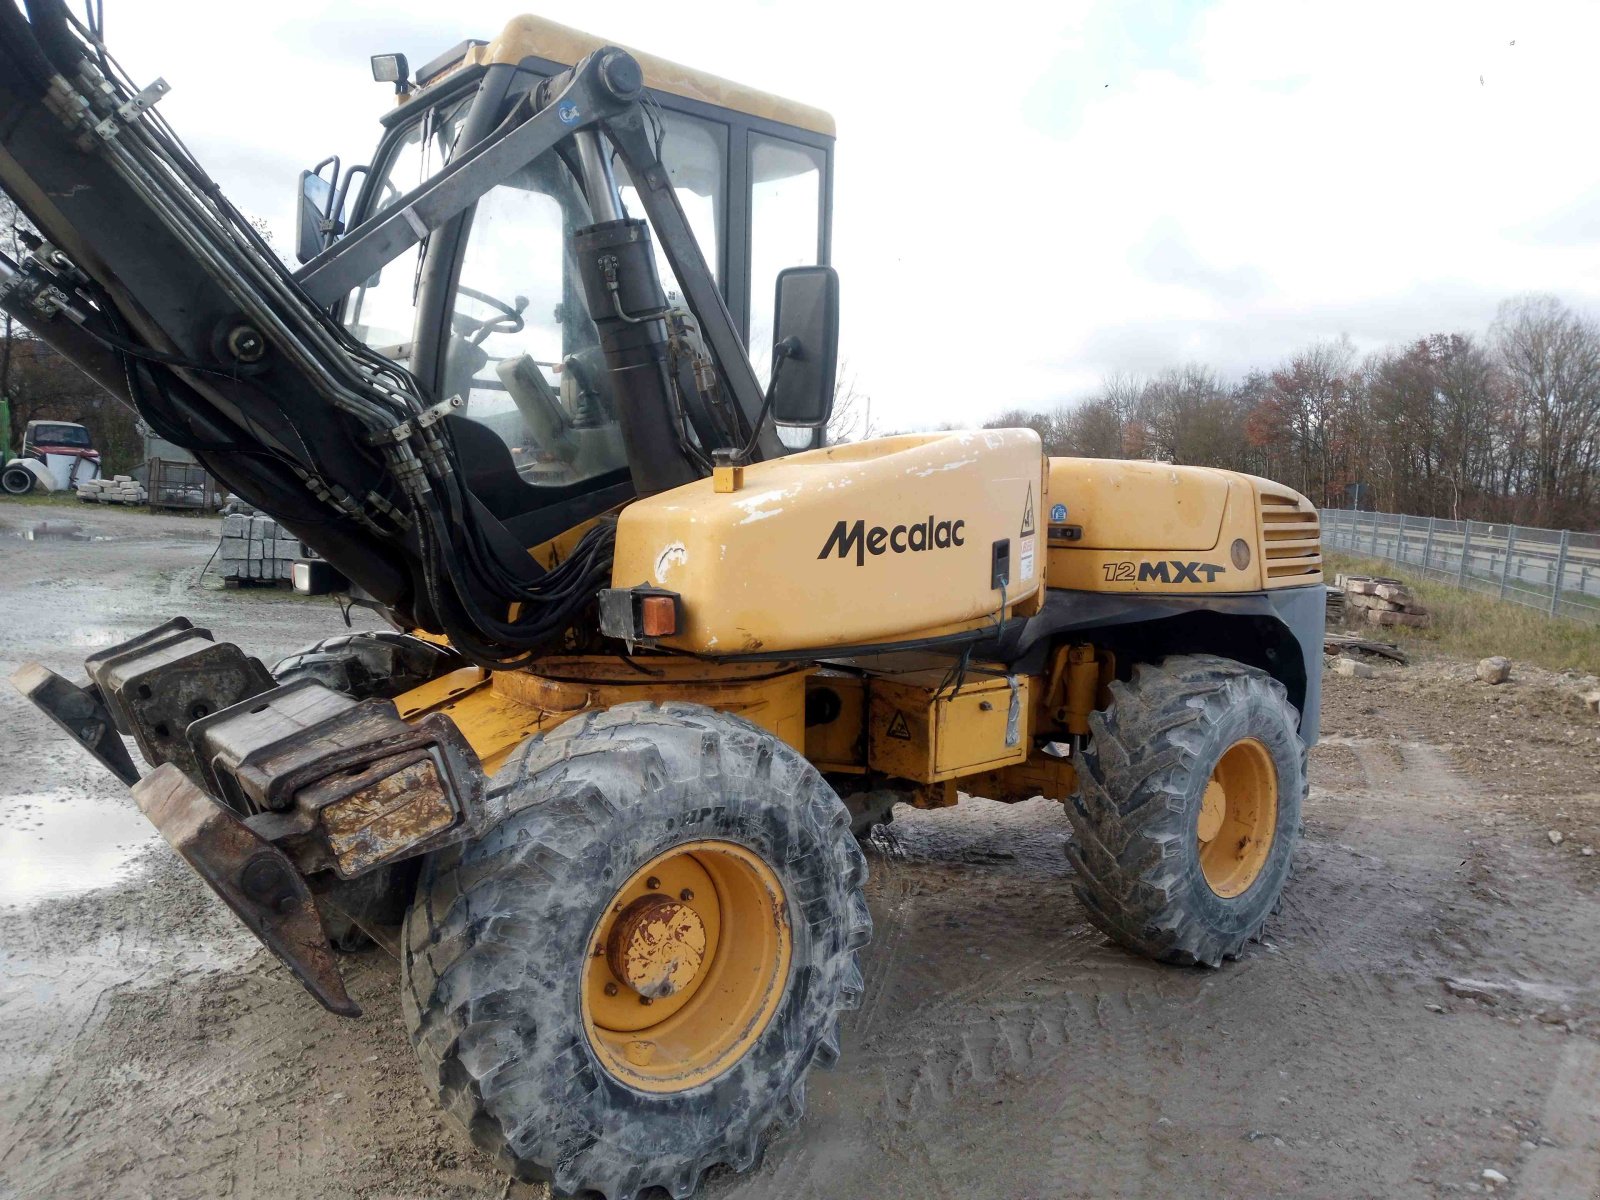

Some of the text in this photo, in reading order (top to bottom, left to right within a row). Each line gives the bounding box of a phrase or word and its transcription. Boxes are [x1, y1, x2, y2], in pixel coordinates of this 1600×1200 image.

[817, 515, 965, 567] Mecalac
[1103, 560, 1226, 584] 12 MXT
